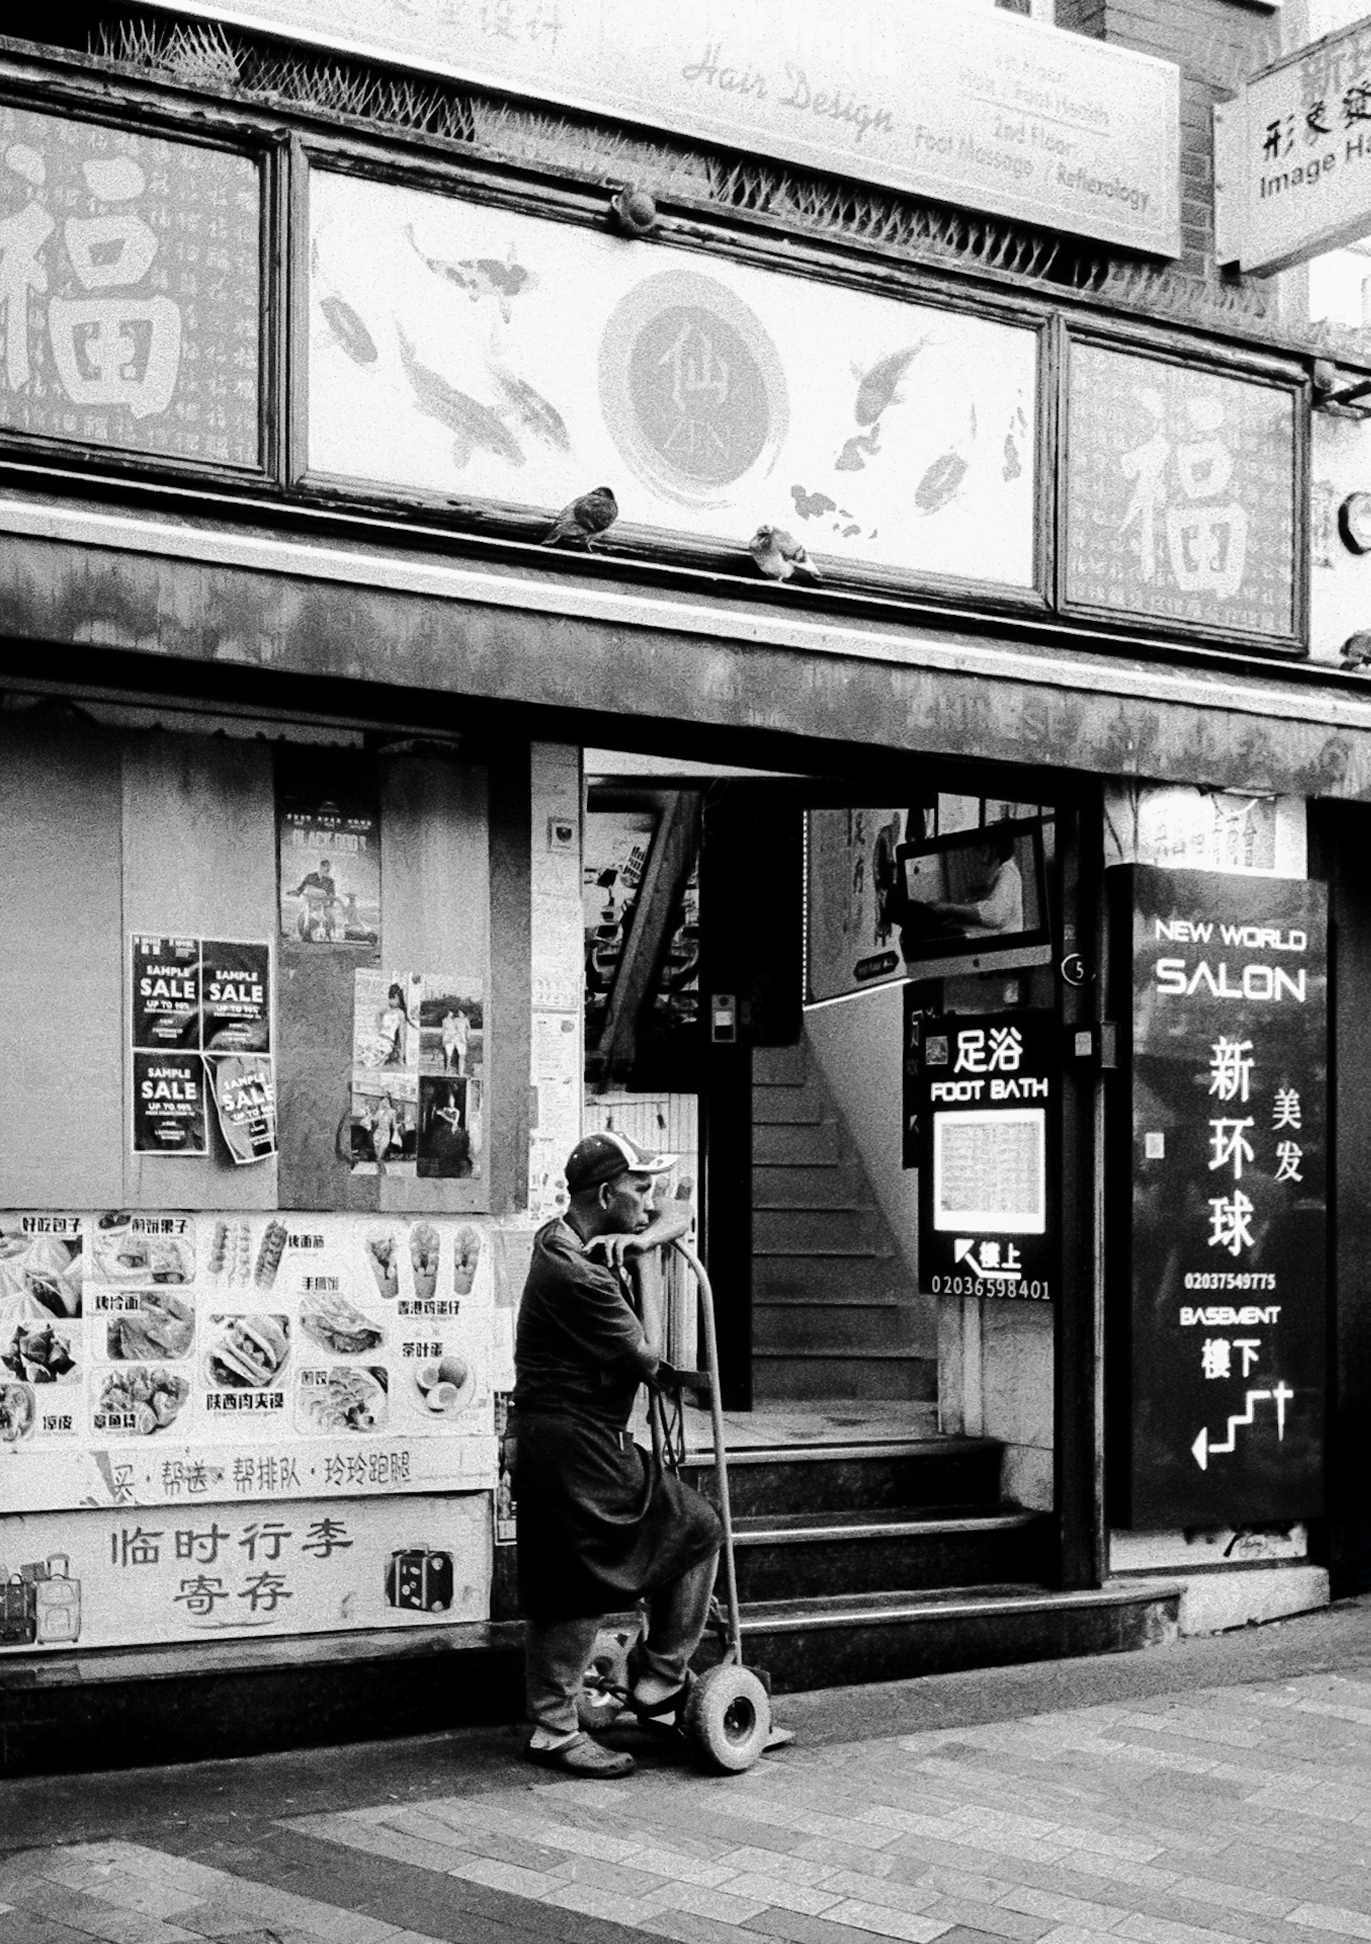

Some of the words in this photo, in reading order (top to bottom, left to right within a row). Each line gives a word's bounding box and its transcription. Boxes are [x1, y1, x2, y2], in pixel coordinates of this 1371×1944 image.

[681, 41, 770, 100] Hair
[778, 61, 895, 144] Design
[992, 114, 1026, 146] 2nd
[914, 123, 954, 156] Foot
[1055, 161, 1151, 213] Reflexology
[1260, 152, 1336, 199] Image
[1117, 387, 1249, 602] 福
[1155, 919, 1214, 944] NEW
[1220, 924, 1308, 952] WORLD
[146, 965, 190, 978] SAMPLE
[215, 970, 258, 982] SAMPLE
[1075, 961, 1085, 979] 5
[1156, 958, 1307, 1003] SALON
[140, 978, 196, 1000] SALE
[209, 983, 264, 1003] SALE
[146, 1000, 160, 1009] UP
[161, 1001, 173, 1009] TO
[216, 1004, 229, 1012] UP
[230, 1005, 242, 1013] TO
[953, 1026, 1024, 1074] 足浴
[147, 1067, 191, 1079] SAMPLE
[223, 1072, 266, 1090] SAMPLE
[141, 1080, 197, 1101] SALE
[221, 1083, 275, 1111] SALE
[931, 1080, 986, 1102] FOOT
[990, 1077, 1049, 1100] BATH
[148, 1102, 161, 1111] UP
[163, 1103, 175, 1111] TO
[231, 1112, 245, 1122] UP
[246, 1109, 260, 1119] TO
[1207, 1035, 1256, 1257] 新环球
[1271, 1087, 1305, 1184] 美发
[22, 1217, 81, 1233] 好吃包子
[131, 1218, 188, 1234] 煎饼果子
[288, 1235, 325, 1249] 烤面筋
[932, 1275, 1051, 1300] 02036598401
[1184, 1272, 1277, 1291] 02037549775
[95, 1295, 139, 1310] 烤冷面
[398, 1300, 460, 1316] 香港鸡蛋仔
[1179, 1305, 1282, 1326] BASEMENT
[402, 1342, 443, 1358] 茶叶蛋
[1201, 1338, 1262, 1379] 樓下
[206, 1392, 285, 1411] 陕西肉夹馍
[111, 1518, 354, 1567] 临时行李
[173, 1570, 294, 1616] 寄存
